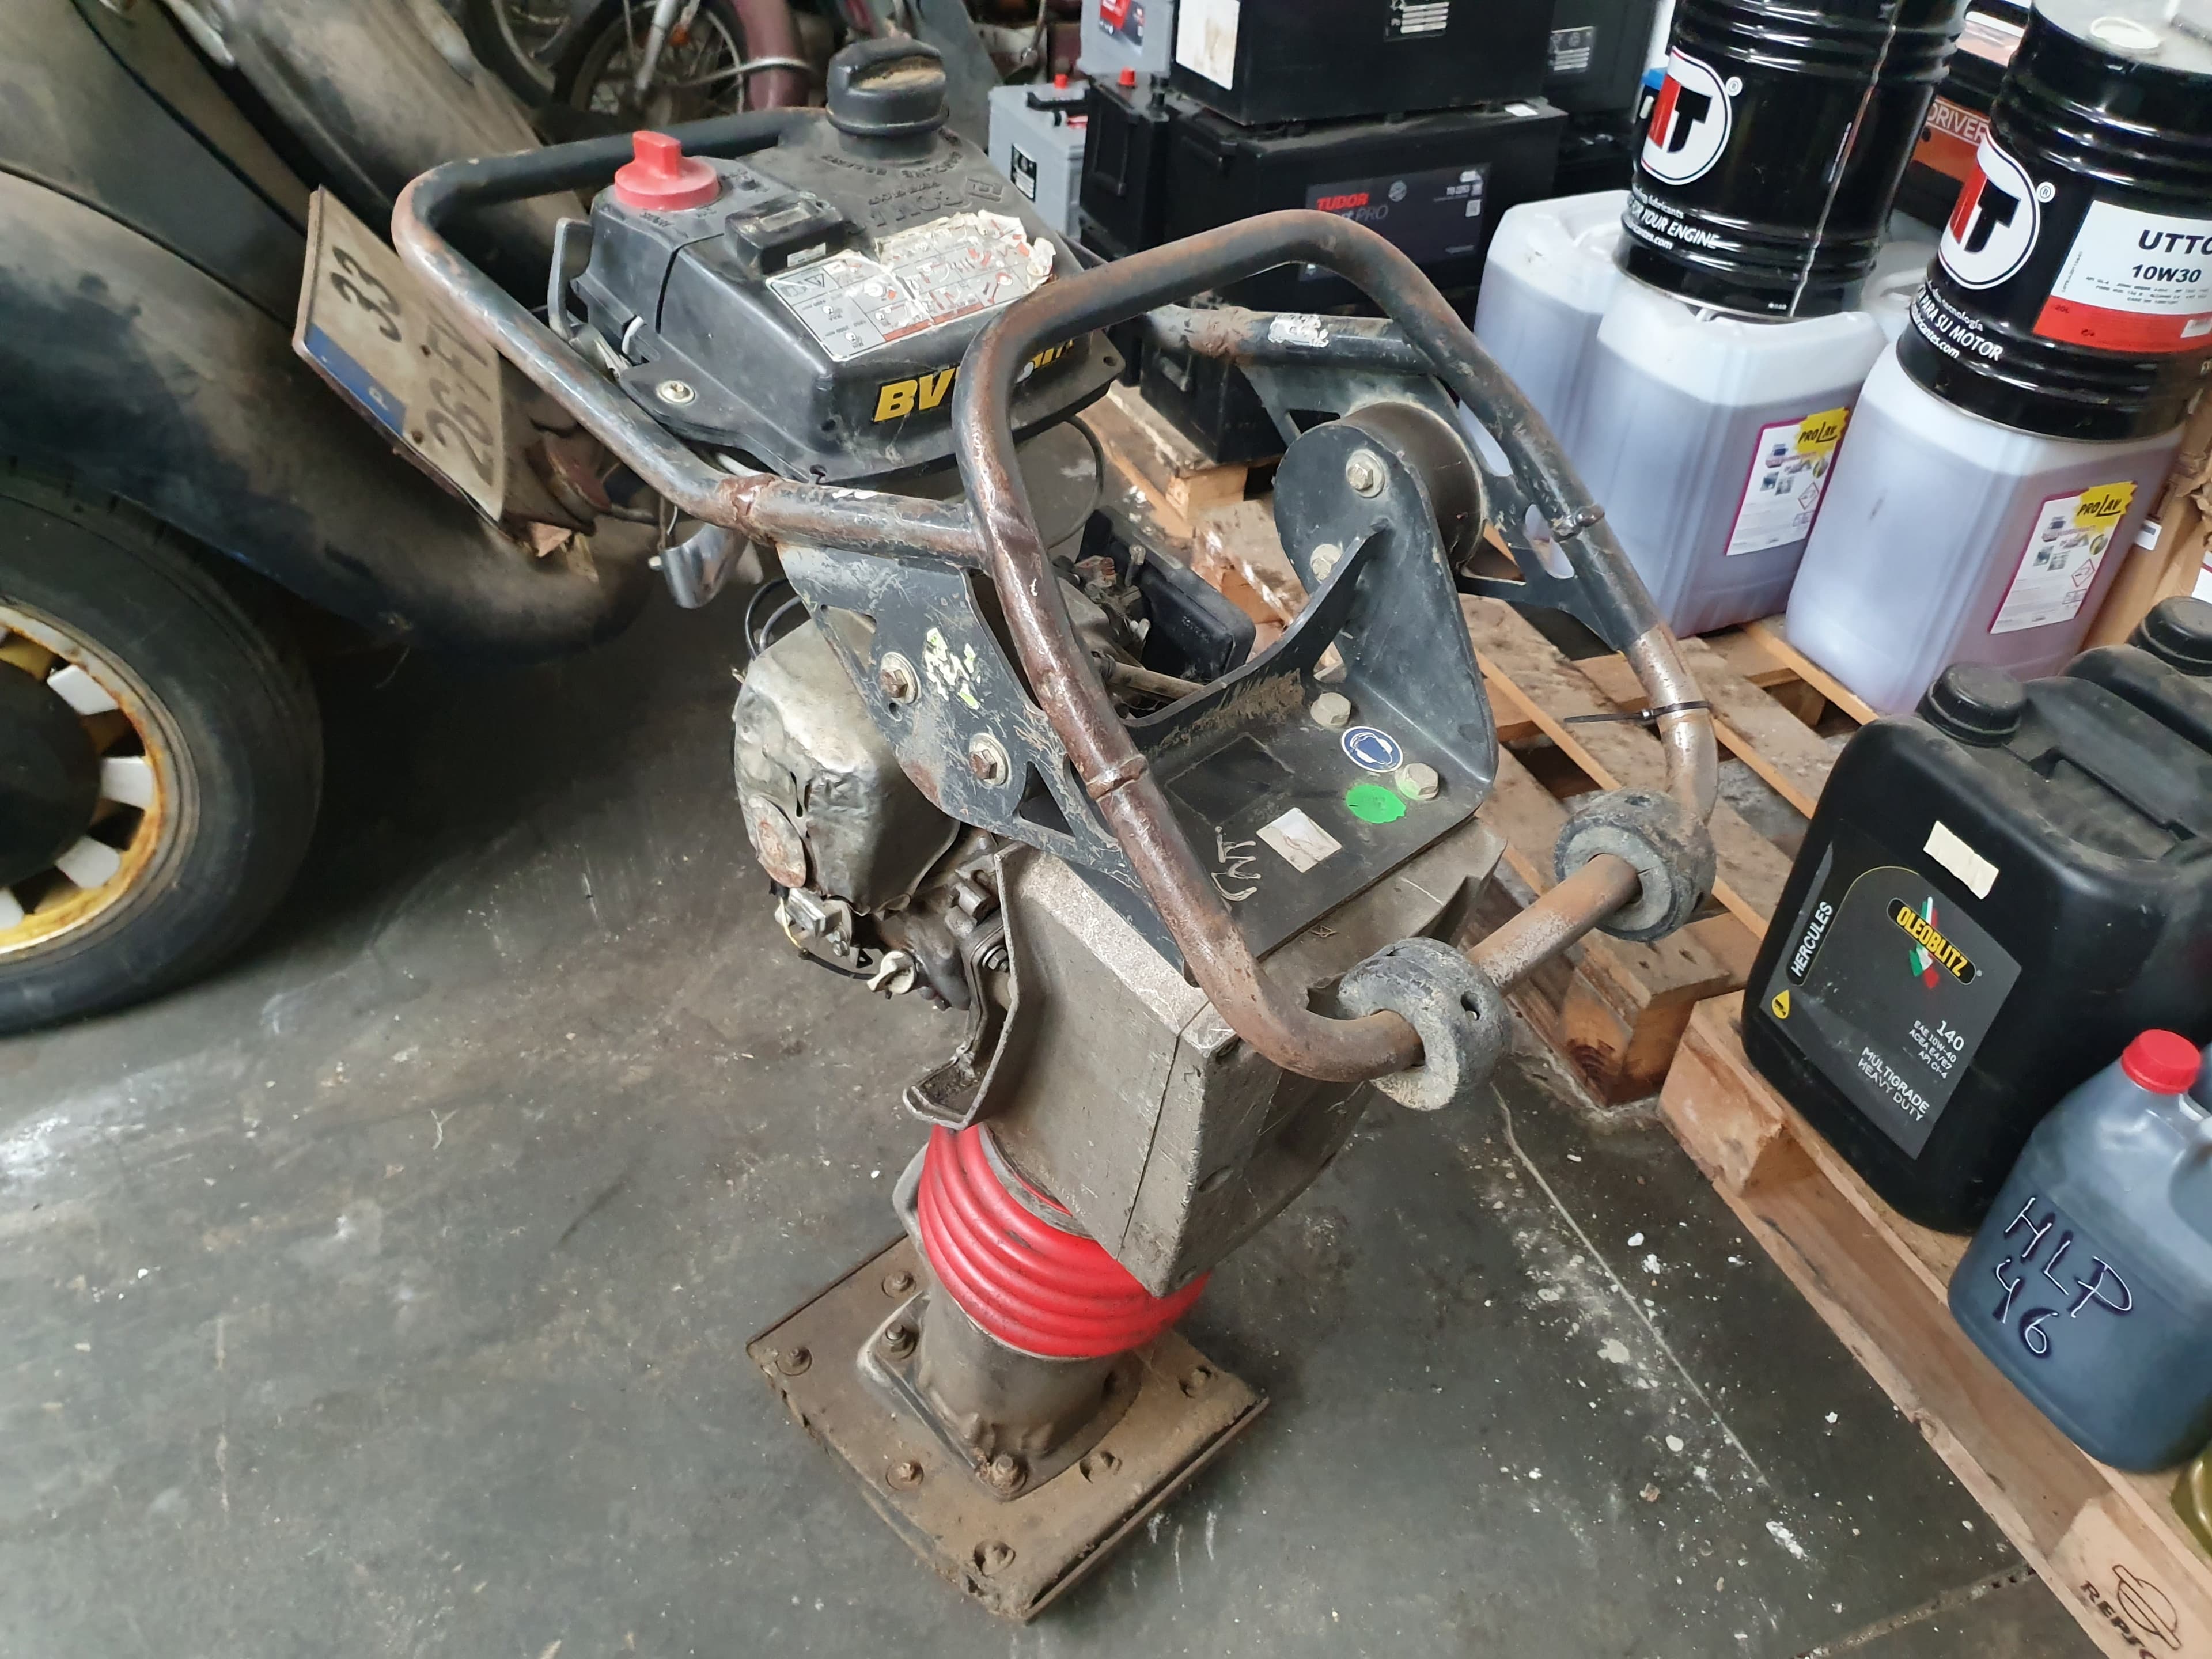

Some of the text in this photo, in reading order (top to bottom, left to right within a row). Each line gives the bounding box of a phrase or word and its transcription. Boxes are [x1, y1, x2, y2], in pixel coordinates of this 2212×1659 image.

[1317, 192, 1369, 211] TUDOR
[1641, 208, 1668, 232] YOUR
[1667, 221, 1721, 249] ENGINE
[329, 244, 402, 343] 33
[2131, 264, 2202, 283] 10W30
[1919, 294, 1939, 323] PARA
[1934, 314, 1953, 333] SU
[1949, 325, 2003, 361] MOTOR
[368, 385, 389, 411] P
[873, 365, 960, 423] BV
[1790, 901, 1834, 978] HERCULES
[1896, 906, 1968, 977] OLEOBLITZ
[1908, 1029, 1953, 1070] ACEA E4/E7
[1918, 1050, 1931, 1065] API
[1927, 1033, 1957, 1063] 10W-40
[1937, 1020, 1964, 1051] 140
[1858, 1058, 1924, 1122] HEAVY DUTY
[1862, 1046, 1930, 1115] MULTIGRADE
[2003, 1195, 2133, 1319] HLP
